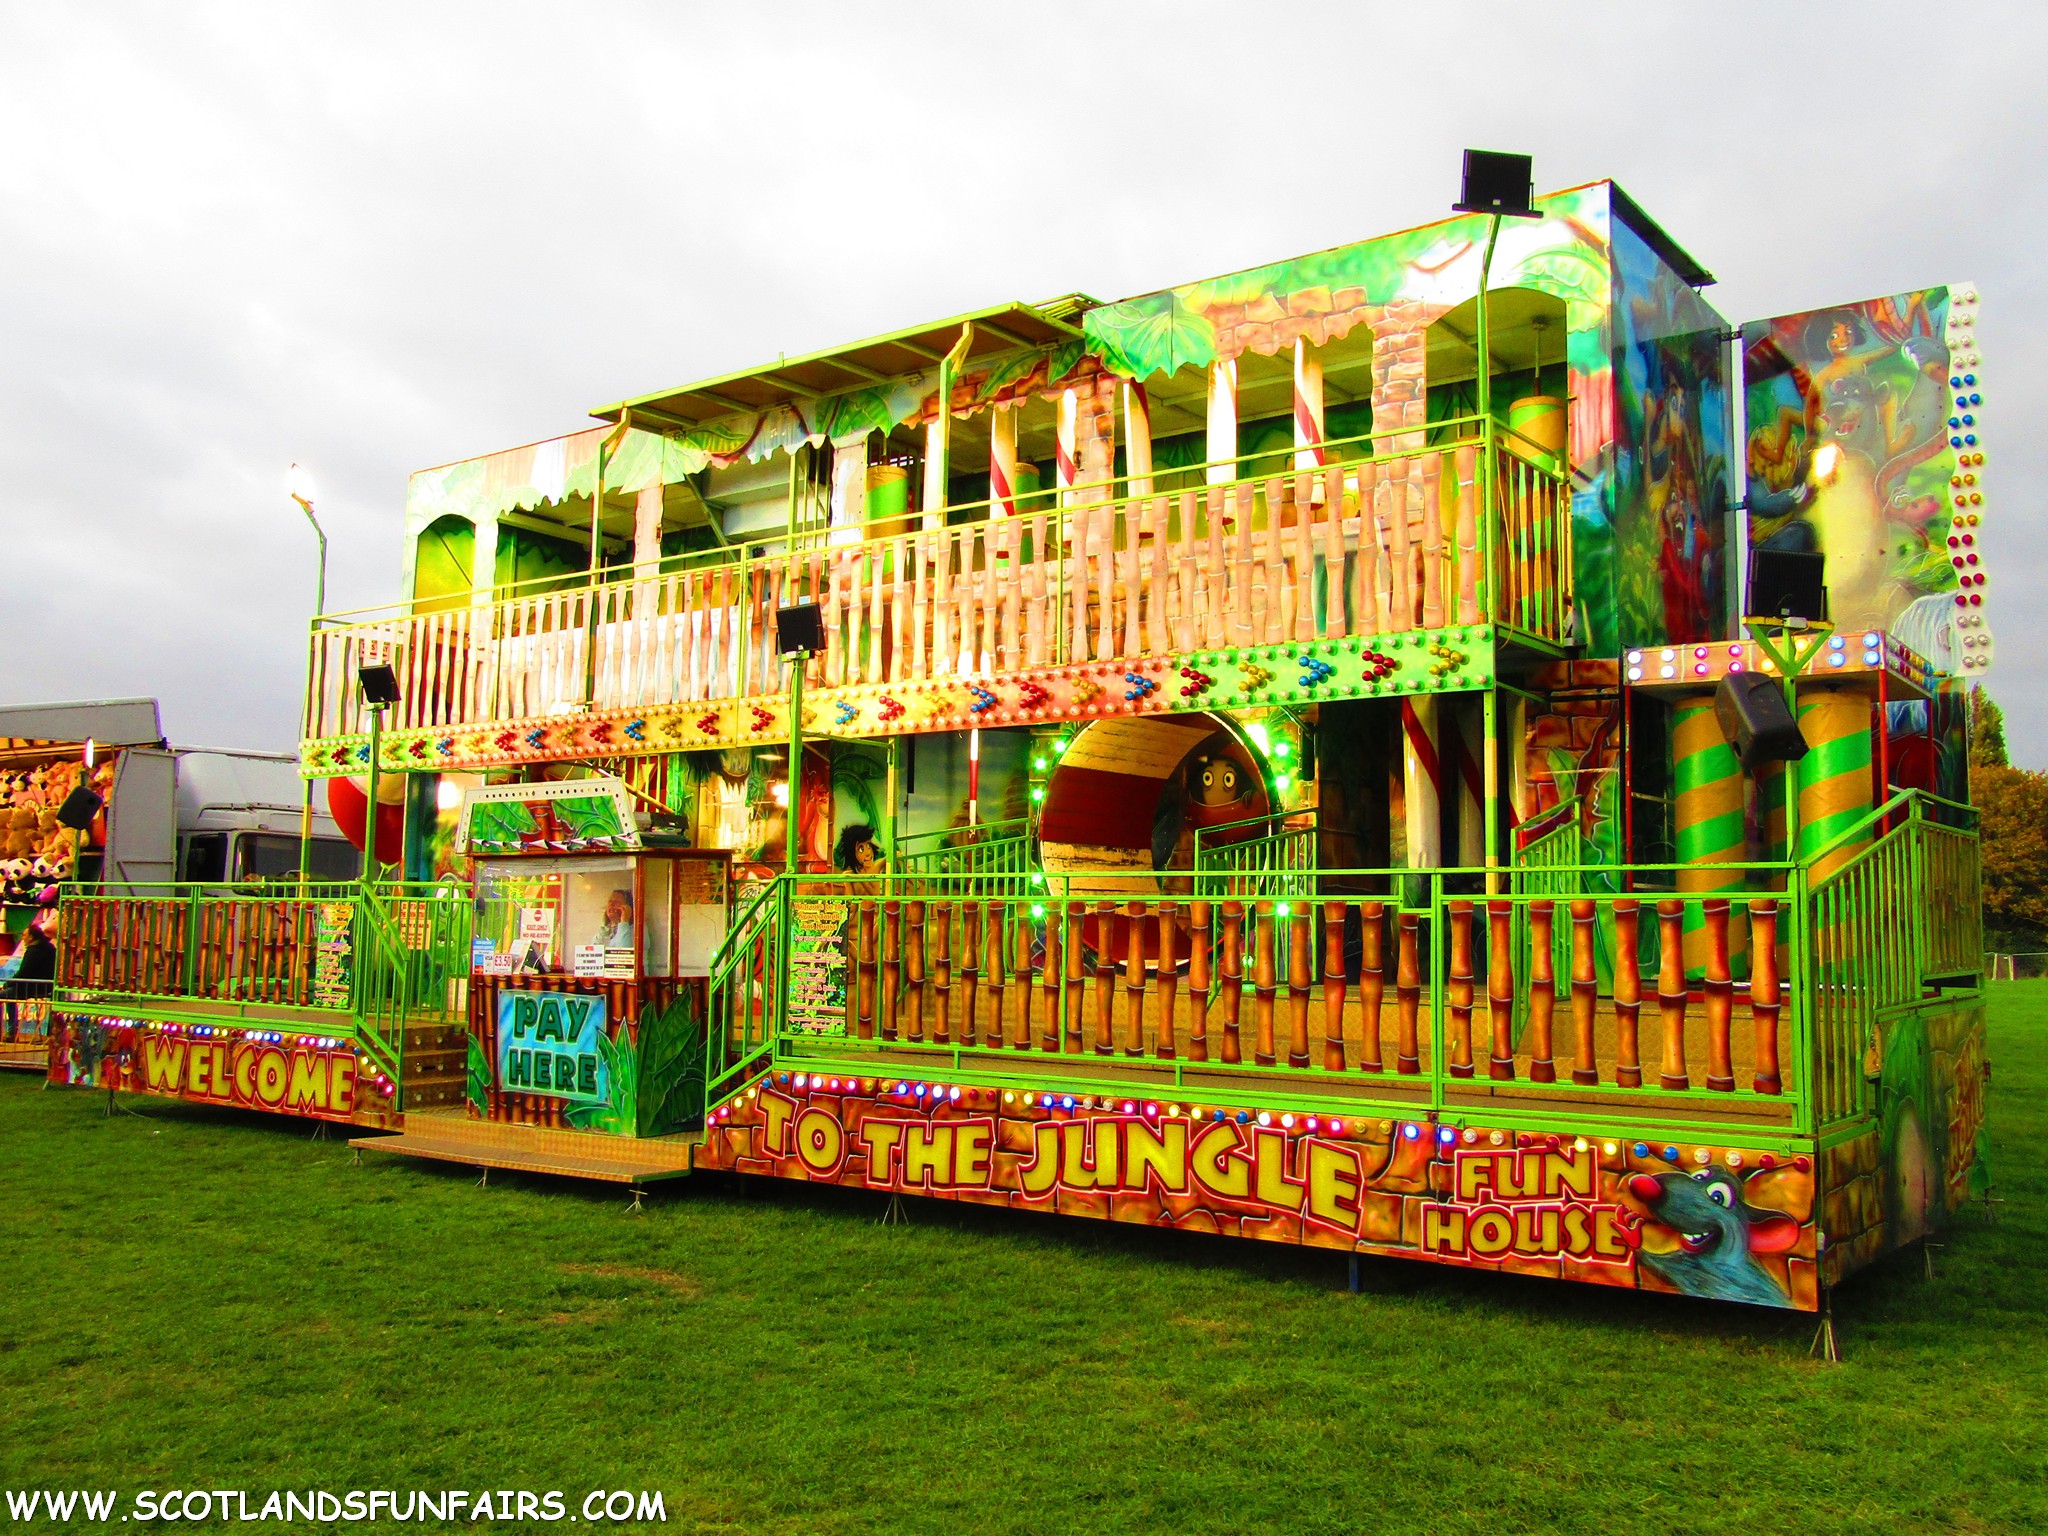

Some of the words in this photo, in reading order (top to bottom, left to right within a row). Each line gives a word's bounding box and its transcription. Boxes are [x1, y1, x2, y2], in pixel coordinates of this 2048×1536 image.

[495, 955, 512, 967] £3.50
[514, 995, 591, 1044] PAY
[144, 1036, 357, 1115] WELCOME
[508, 1046, 598, 1095] HERE
[756, 1086, 843, 1176] TO
[859, 1117, 995, 1190] THE
[1018, 1118, 1364, 1236] JUNGLE
[1455, 1148, 1597, 1204] FUN
[1422, 1203, 1632, 1265] HOUSE
